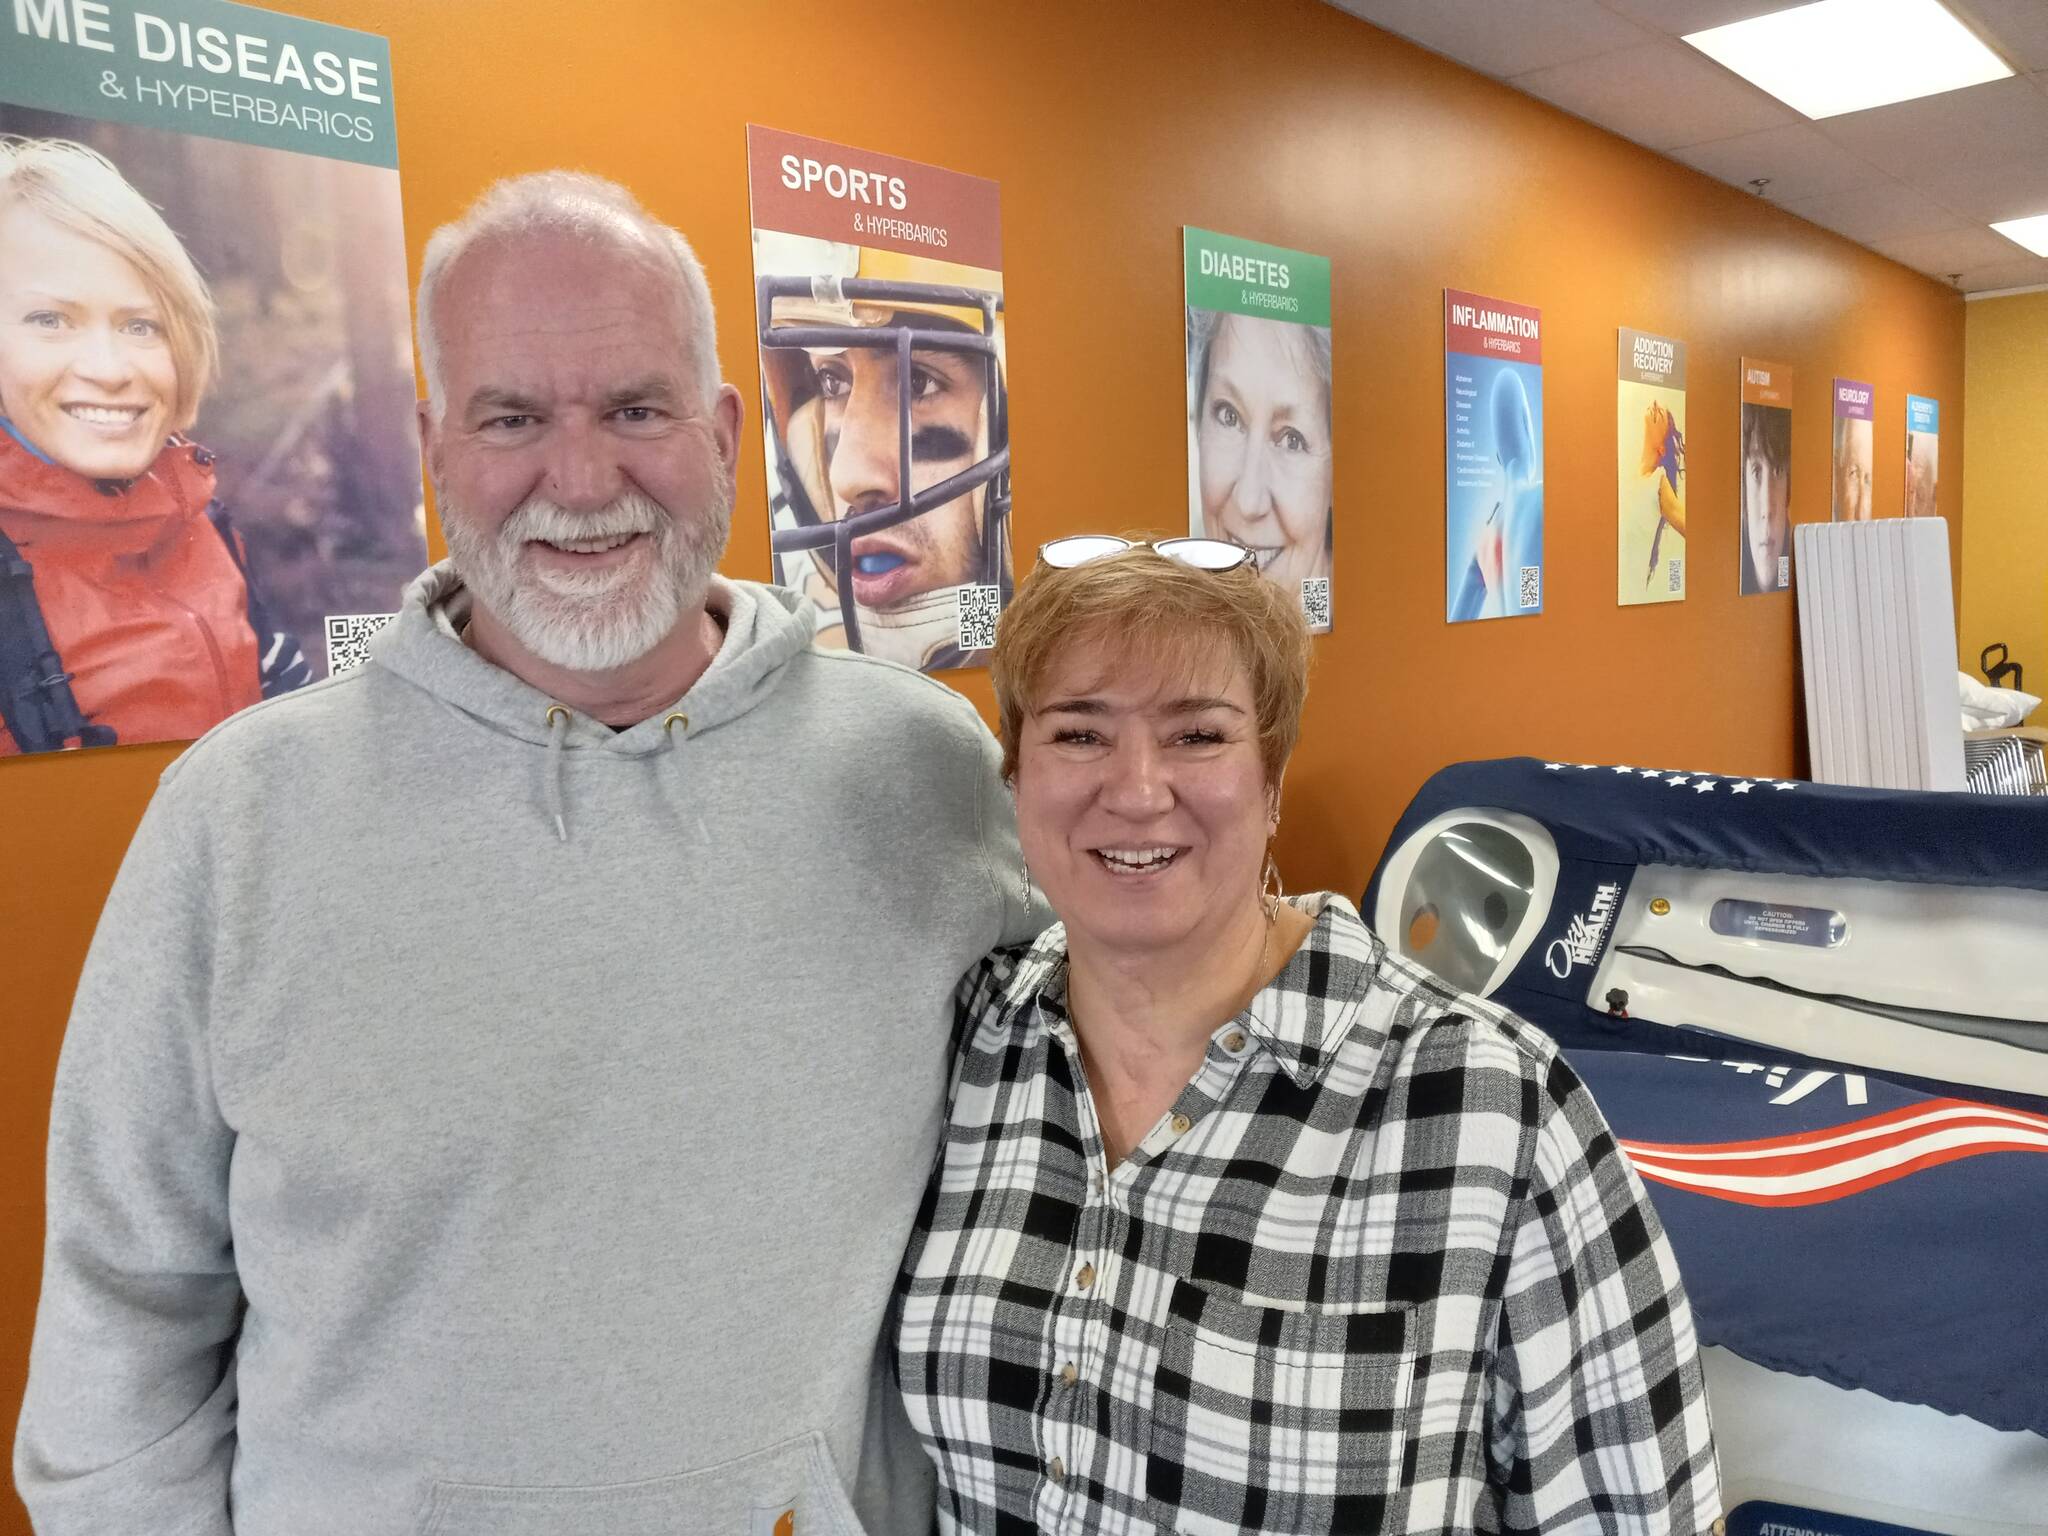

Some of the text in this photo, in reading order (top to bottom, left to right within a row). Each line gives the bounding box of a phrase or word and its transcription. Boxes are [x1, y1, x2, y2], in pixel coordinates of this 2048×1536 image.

[134, 12, 382, 105] DISEASE
[100, 70, 375, 143] & HYPERBARICS
[781, 154, 907, 211] SPORTS
[853, 212, 948, 248] & HYPERBARICS
[1200, 248, 1290, 289] DIABETES
[1241, 289, 1299, 313] & HYPERBARICS
[1452, 304, 1539, 340] INFLAMMATION
[1489, 338, 1521, 354] HYPERBARICS
[1633, 336, 1674, 359] ADDICTION
[1633, 352, 1673, 375] RECOVERY
[1838, 387, 1869, 405] NEUROLOGY
[1572, 883, 1616, 965] HEALTH
